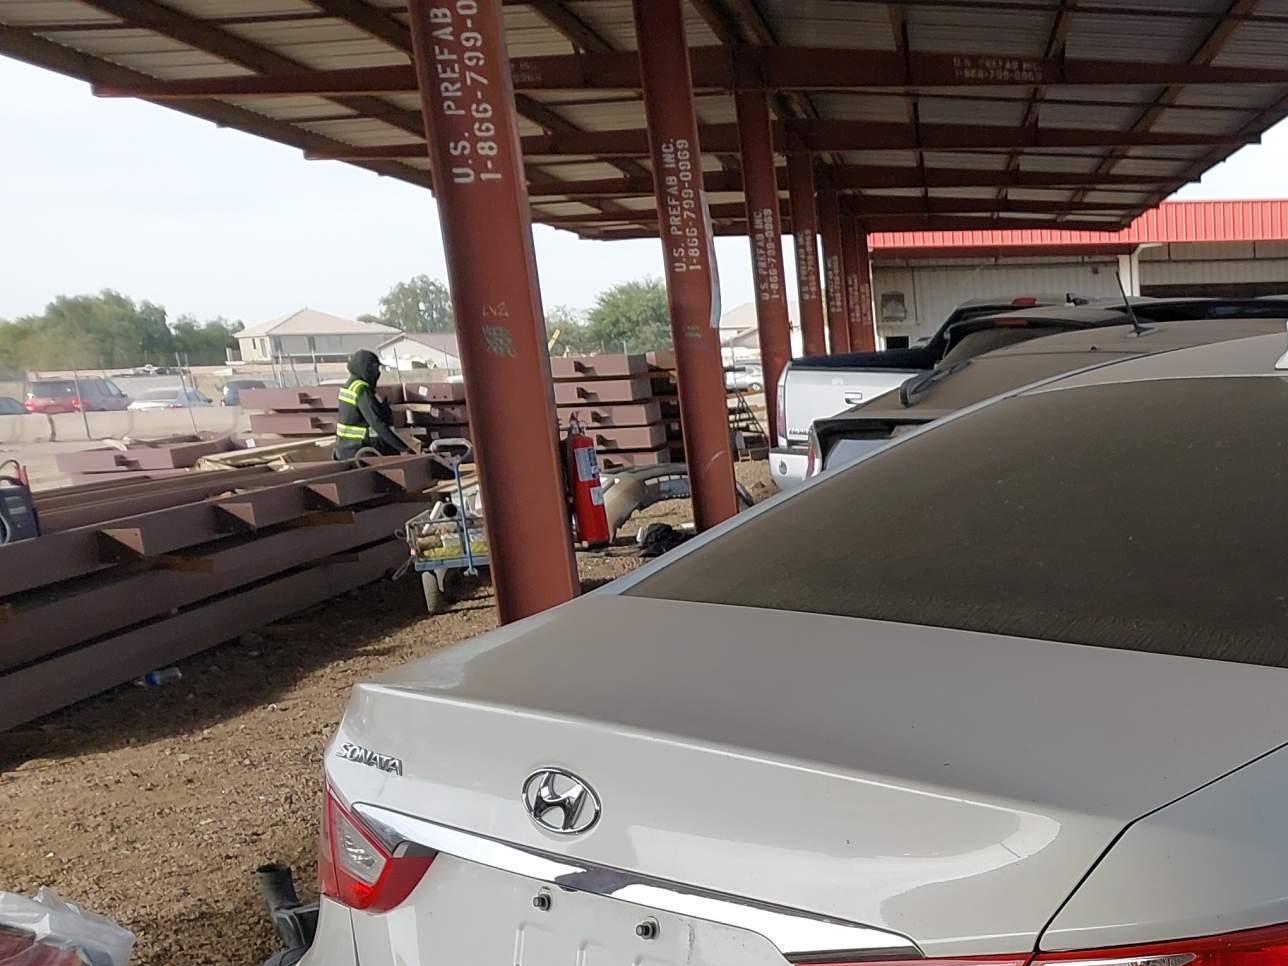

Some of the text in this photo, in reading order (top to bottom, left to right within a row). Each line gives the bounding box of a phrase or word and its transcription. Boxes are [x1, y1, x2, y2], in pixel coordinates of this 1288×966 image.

[430, 7, 476, 184] U.S. PREFAB
[662, 138, 687, 273] U.S. PREFAB INC.
[676, 139, 702, 271] 1-866-799-0969
[754, 233, 769, 275] PREFAB
[336, 742, 403, 777] SONATA
